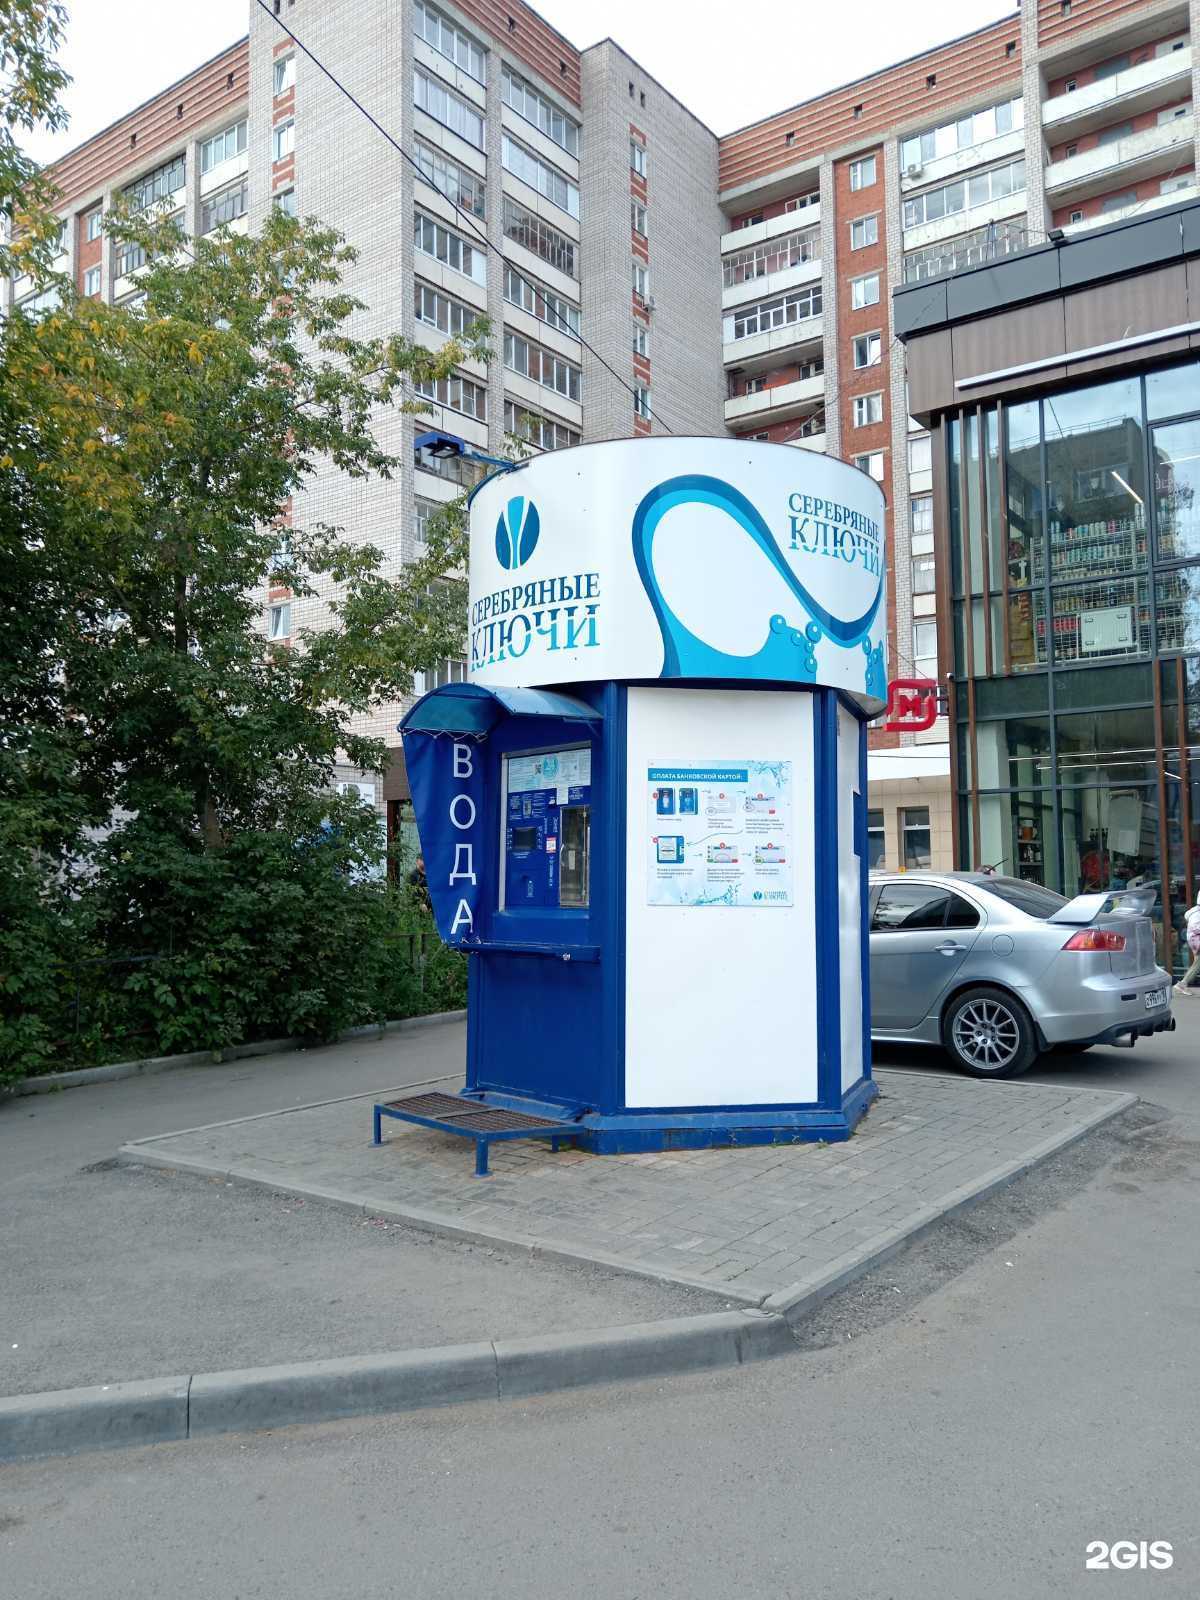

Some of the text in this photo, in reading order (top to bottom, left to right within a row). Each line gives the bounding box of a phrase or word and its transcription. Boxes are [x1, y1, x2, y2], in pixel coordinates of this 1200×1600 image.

[788, 493, 880, 543] СЕРЕБРЯНЫЕ
[788, 515, 880, 577] КЛЮЧИ
[472, 573, 600, 626] СЕРЕБРЯНЫЕ
[471, 604, 600, 672] КЛЮЧИ
[449, 743, 477, 935] ВОДА
